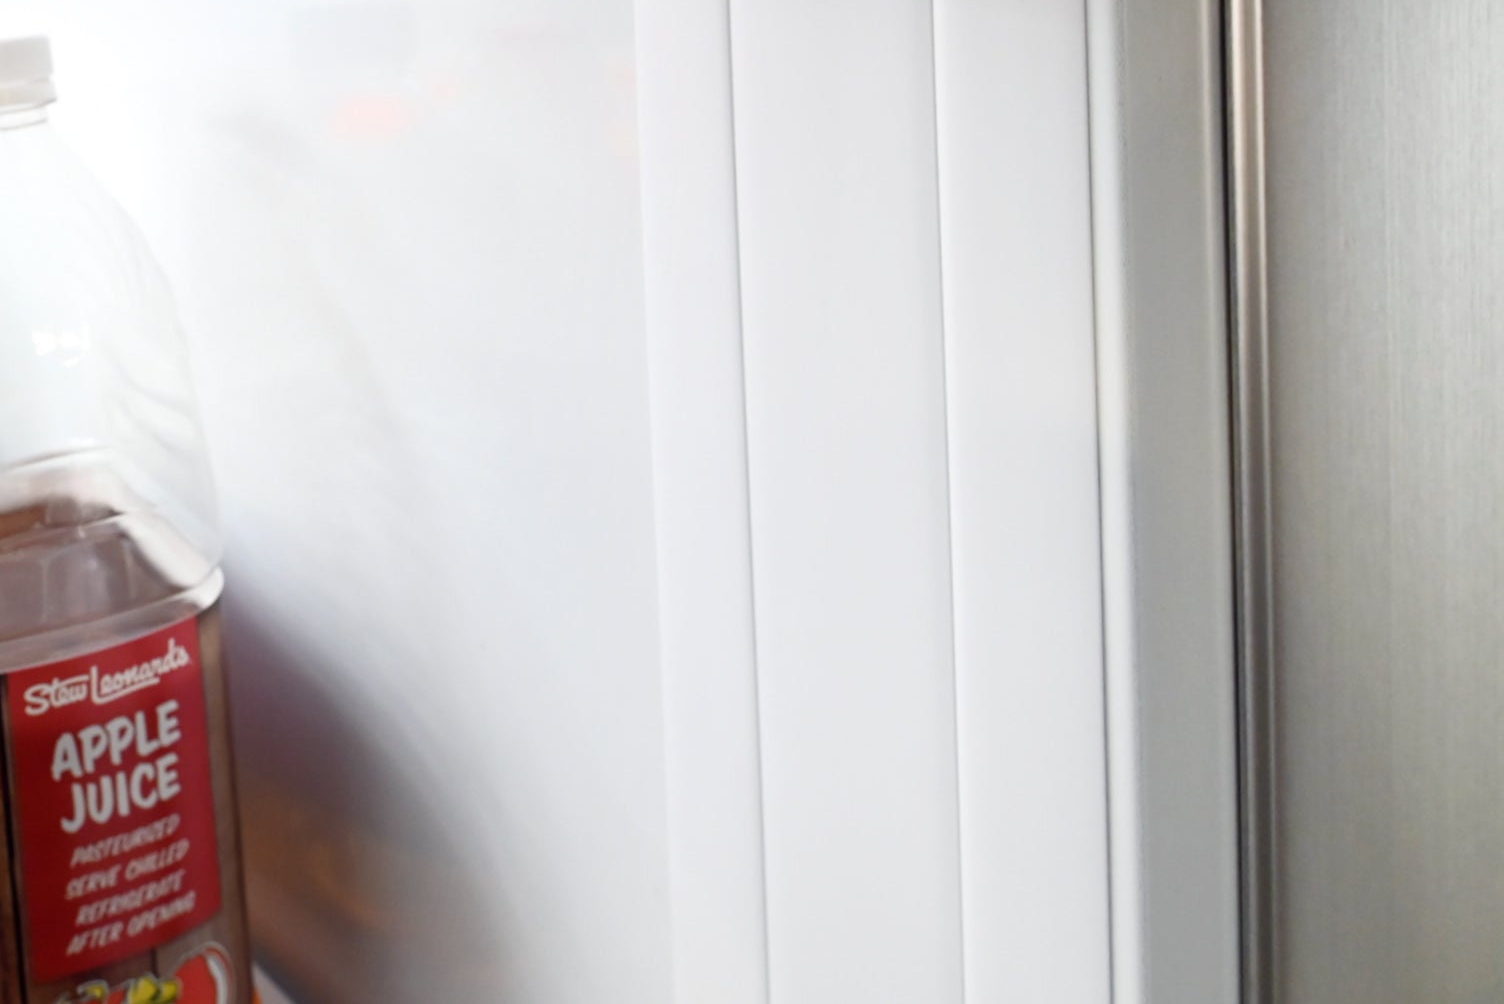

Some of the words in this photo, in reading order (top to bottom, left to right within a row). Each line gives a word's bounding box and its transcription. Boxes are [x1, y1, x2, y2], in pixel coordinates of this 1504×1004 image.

[24, 674, 90, 715] Stew
[51, 699, 182, 782] APPLE
[60, 752, 182, 833] JUICE
[65, 864, 122, 900] SERVE
[125, 838, 190, 881] CHILLED
[70, 813, 180, 869] PASTEURIZED
[66, 921, 124, 957] AFTER
[127, 890, 196, 937] OPENING
[75, 869, 185, 926] REFRIGERATE
